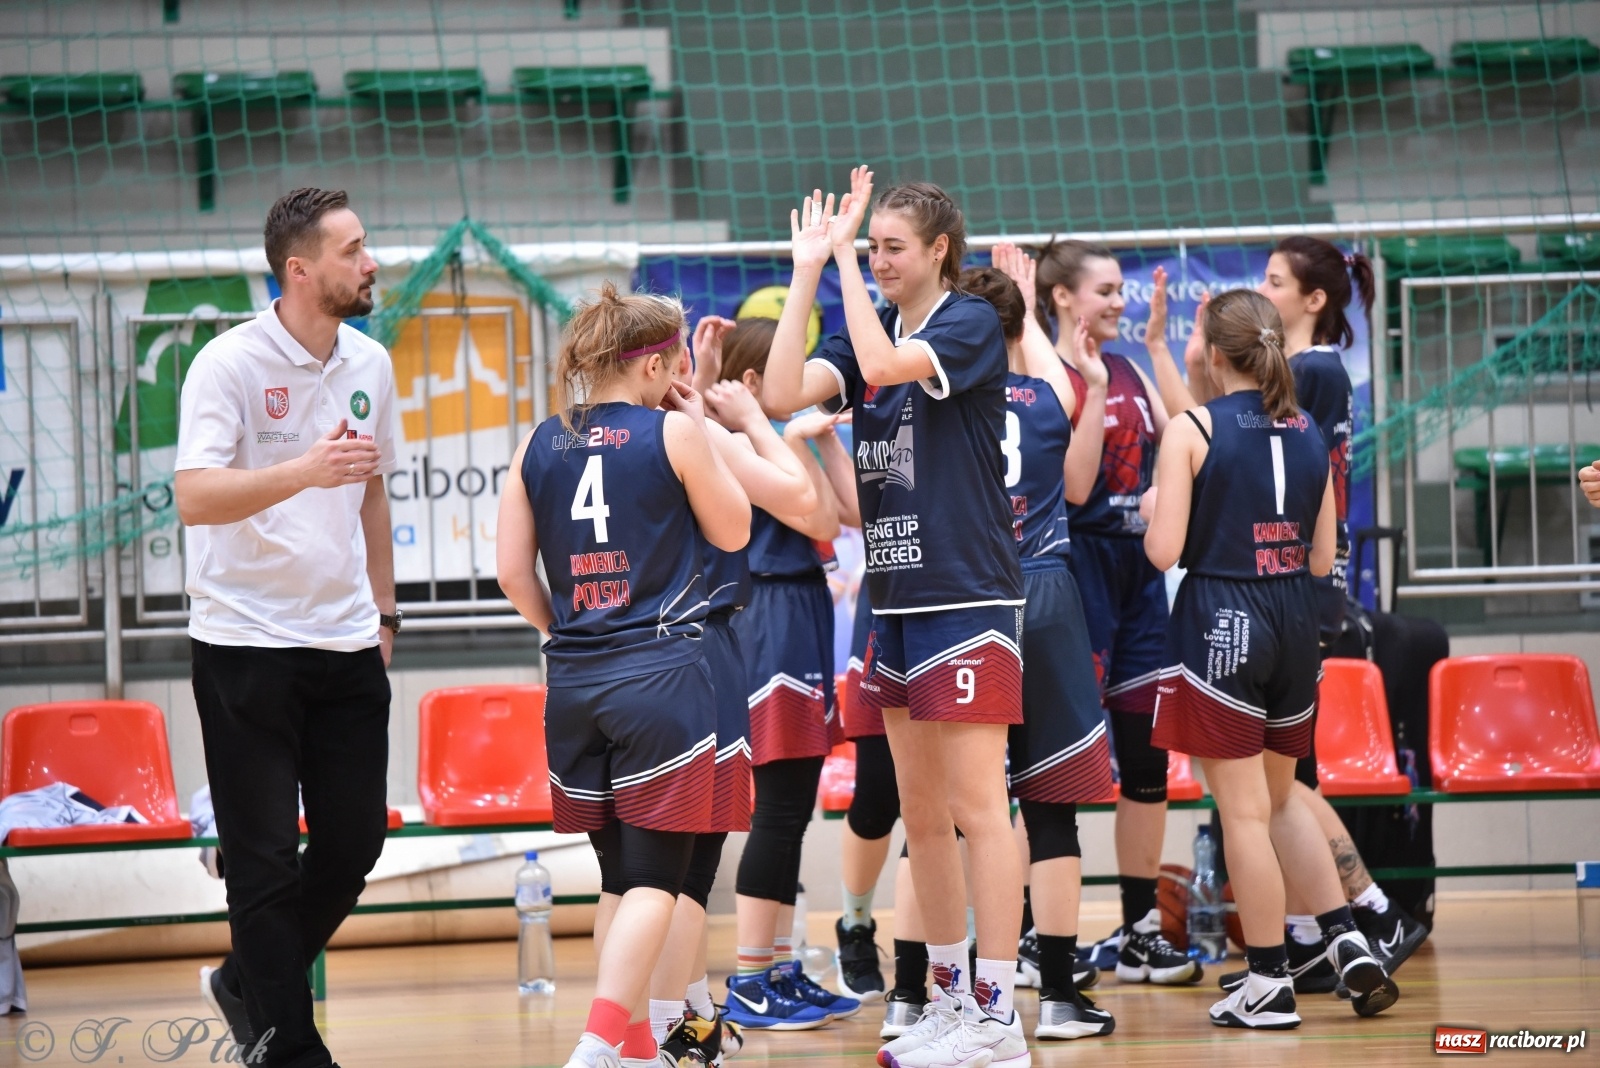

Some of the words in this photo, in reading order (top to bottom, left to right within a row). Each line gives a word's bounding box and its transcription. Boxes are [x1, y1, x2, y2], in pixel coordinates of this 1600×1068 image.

[1269, 435, 1286, 515] 1
[571, 454, 610, 544] 4
[896, 520, 919, 537] UP
[897, 538, 911, 547] way
[912, 536, 921, 545] to
[1255, 544, 1305, 576] POLSKA
[573, 580, 630, 612] POLSKA
[1240, 618, 1250, 655] PASSION
[956, 667, 975, 704] 9
